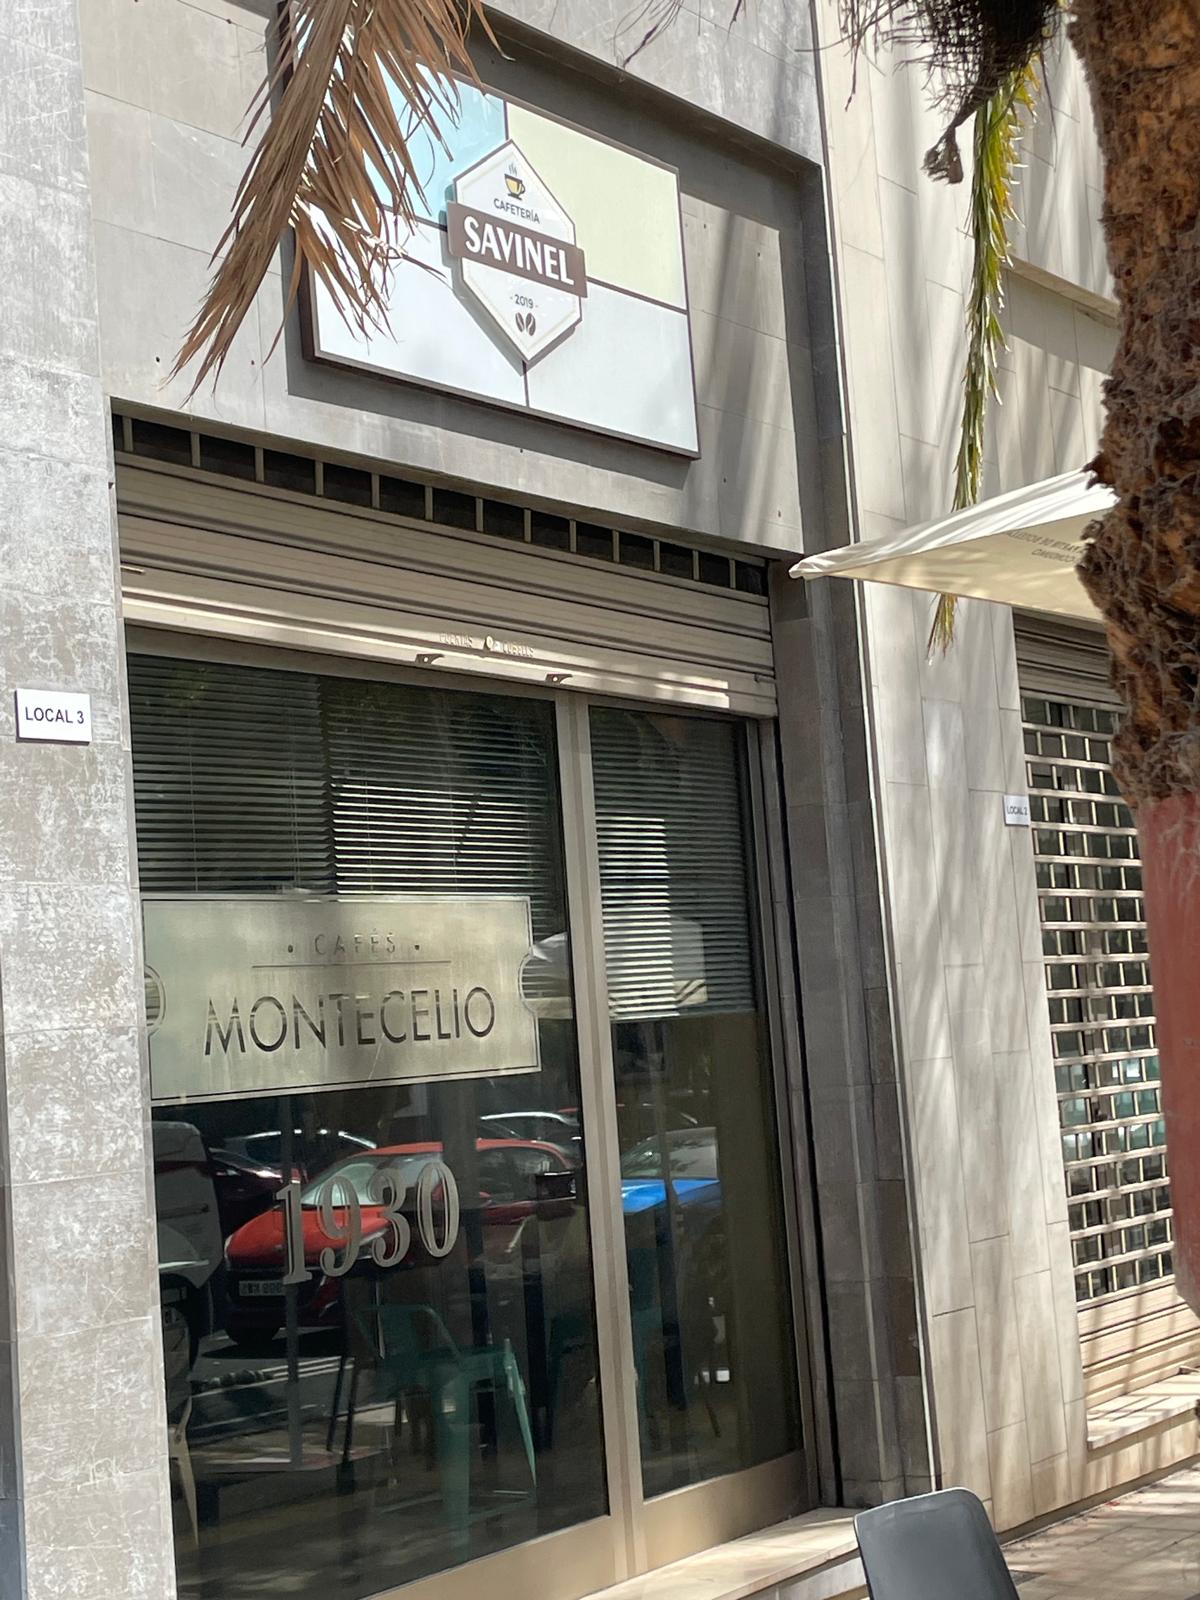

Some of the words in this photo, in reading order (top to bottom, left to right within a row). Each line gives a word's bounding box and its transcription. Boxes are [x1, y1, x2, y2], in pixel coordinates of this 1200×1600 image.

[493, 197, 540, 224] CAFETERÍA
[463, 215, 575, 286] SAVINEL
[514, 293, 534, 309] 2019
[25, 706, 74, 724] LOCAL
[76, 710, 85, 725] 3
[314, 928, 397, 955] CAFÉS
[204, 986, 496, 1056] MONTECELIO
[275, 1160, 460, 1285] 1930
